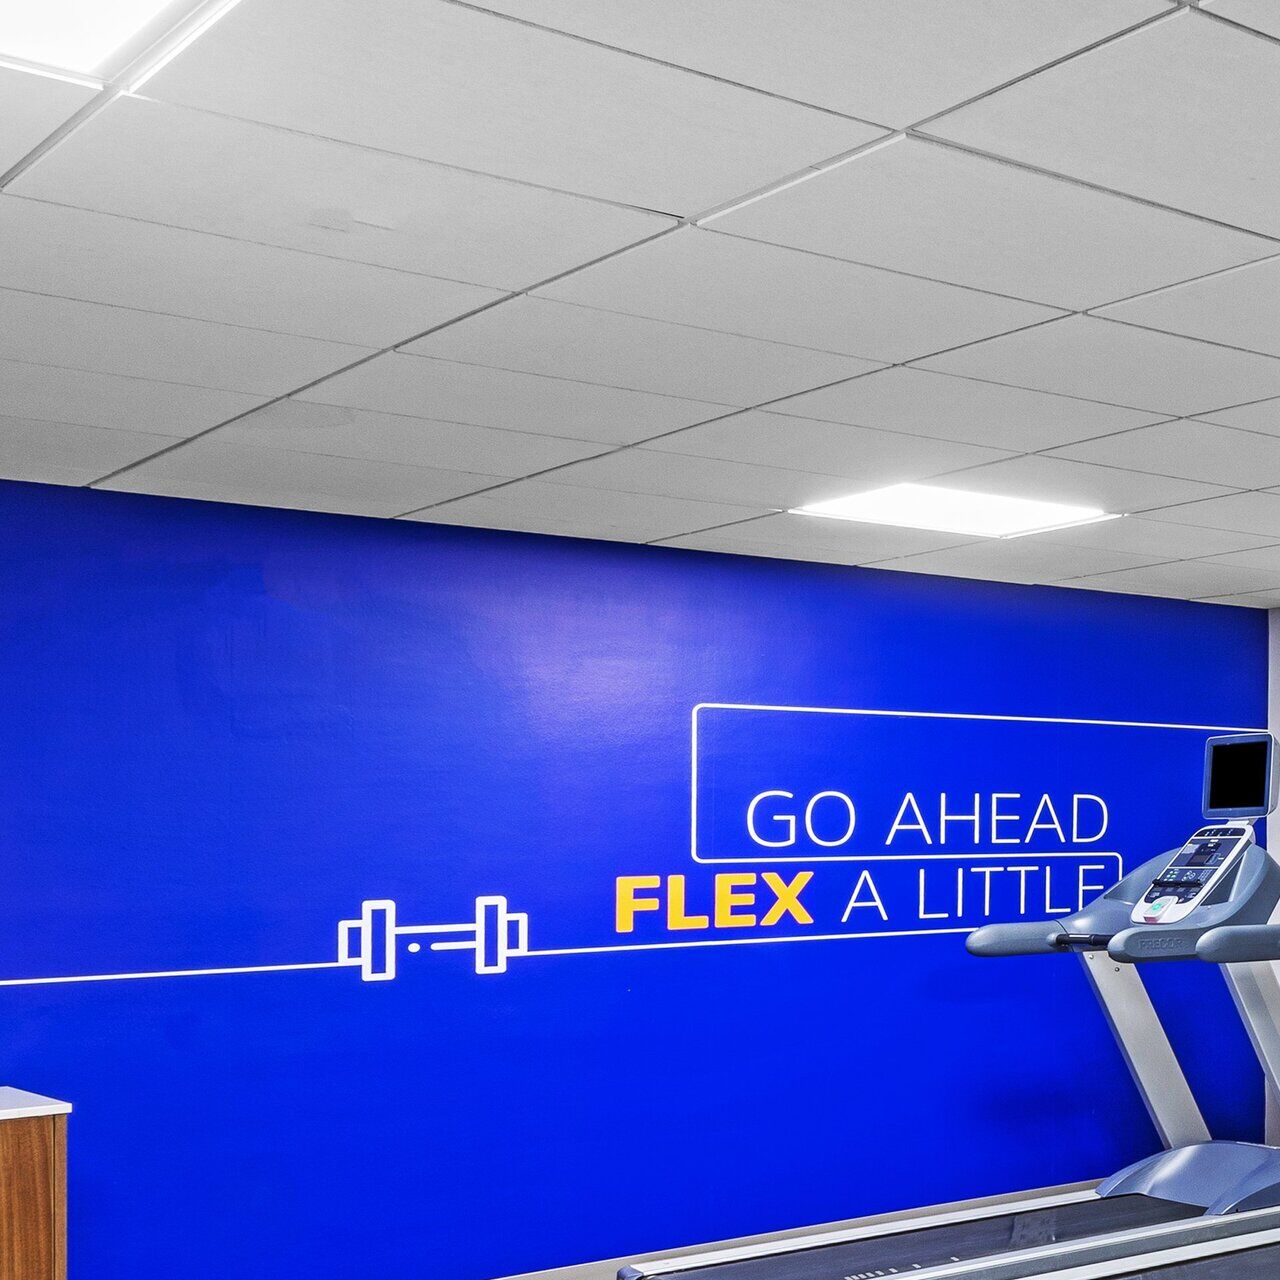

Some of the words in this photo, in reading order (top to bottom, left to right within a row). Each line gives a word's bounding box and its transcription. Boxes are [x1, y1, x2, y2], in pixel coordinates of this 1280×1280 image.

[746, 789, 856, 848] GO
[885, 792, 1109, 847] AHEAD
[615, 871, 815, 933] FLEX
[840, 869, 889, 923] A
[918, 864, 1106, 919] LITTLE
